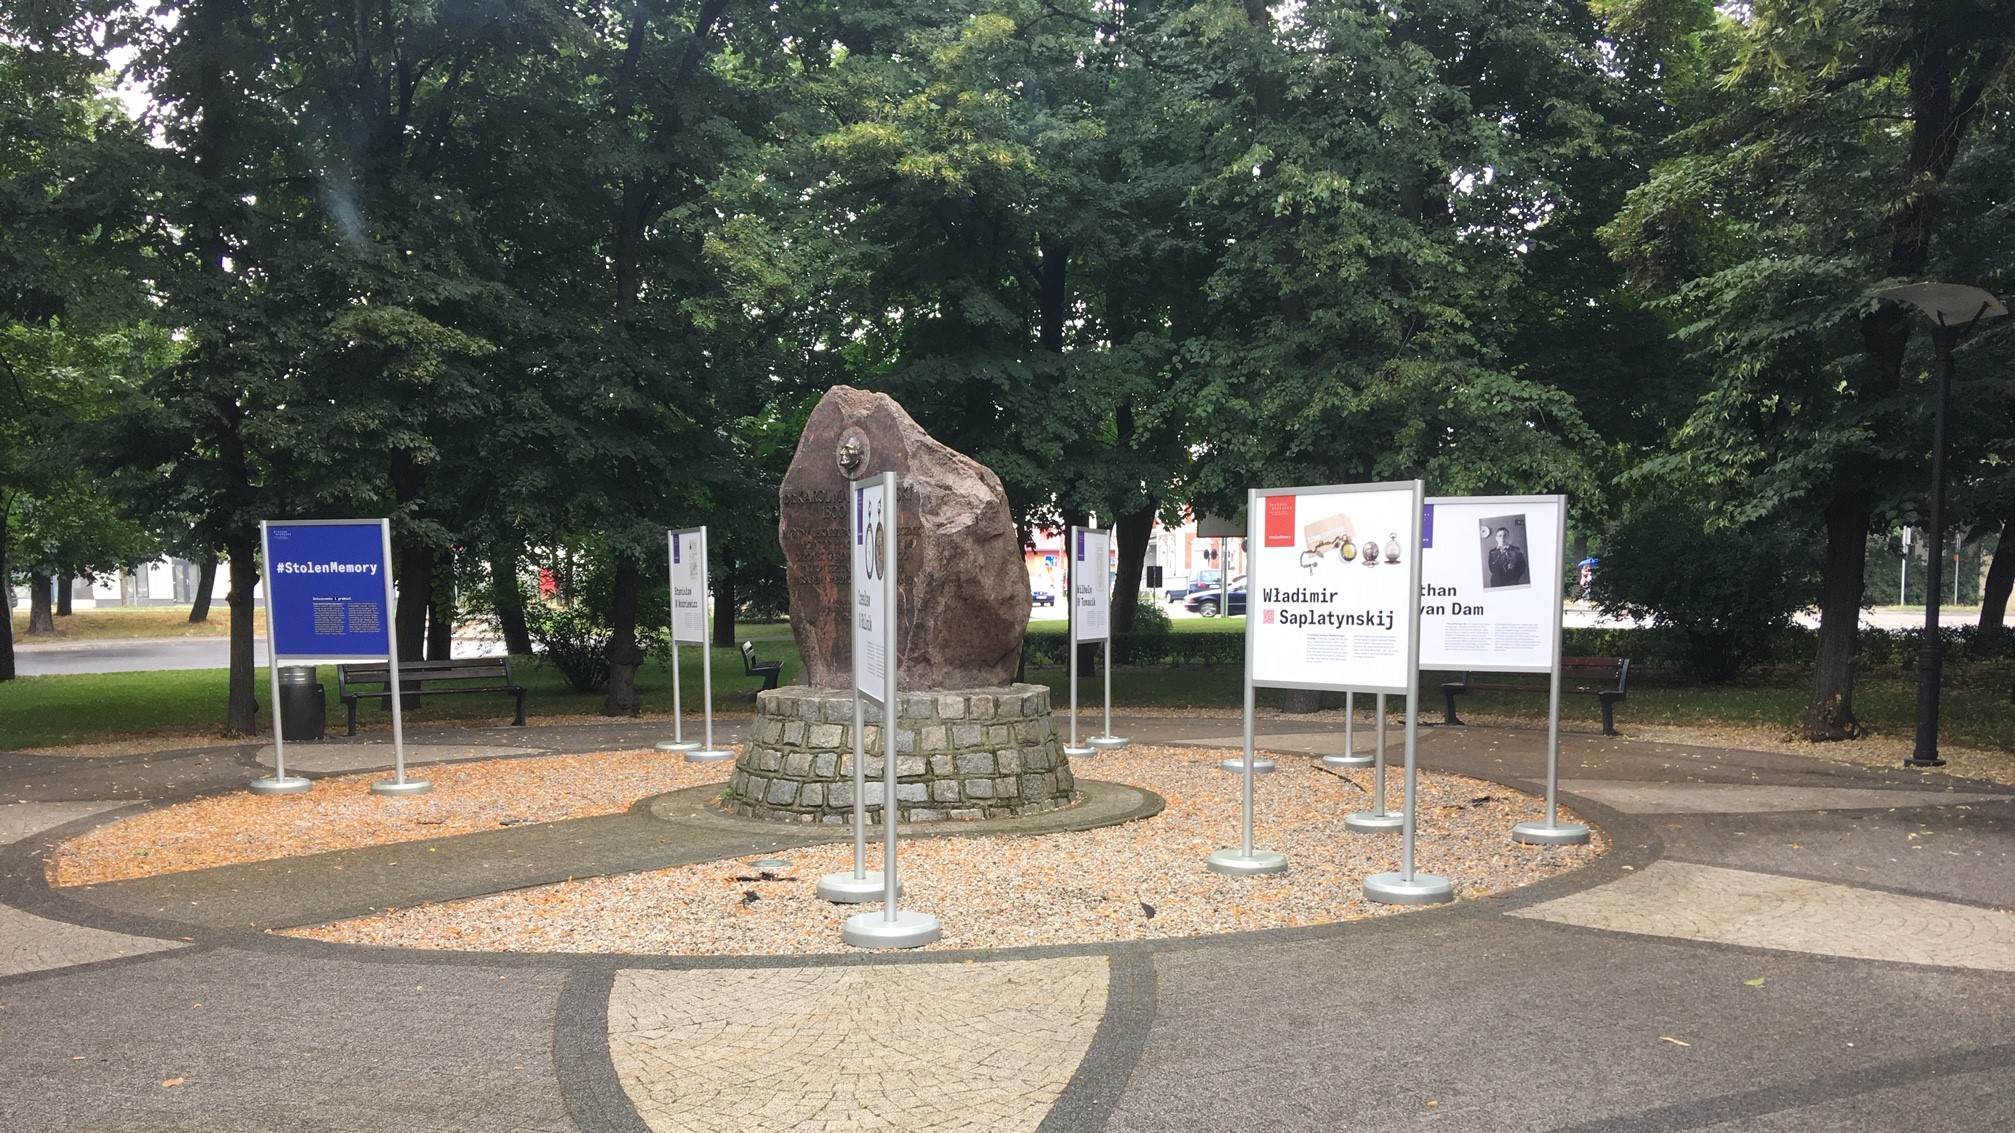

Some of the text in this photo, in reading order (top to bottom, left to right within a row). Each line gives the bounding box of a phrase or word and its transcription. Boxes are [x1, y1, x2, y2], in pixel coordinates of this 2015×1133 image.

[276, 561, 378, 575] #StolenMemory
[1263, 588, 1339, 603] Władimir
[1451, 602, 1485, 616] Dam
[1279, 609, 1394, 631] Saplatynskij
